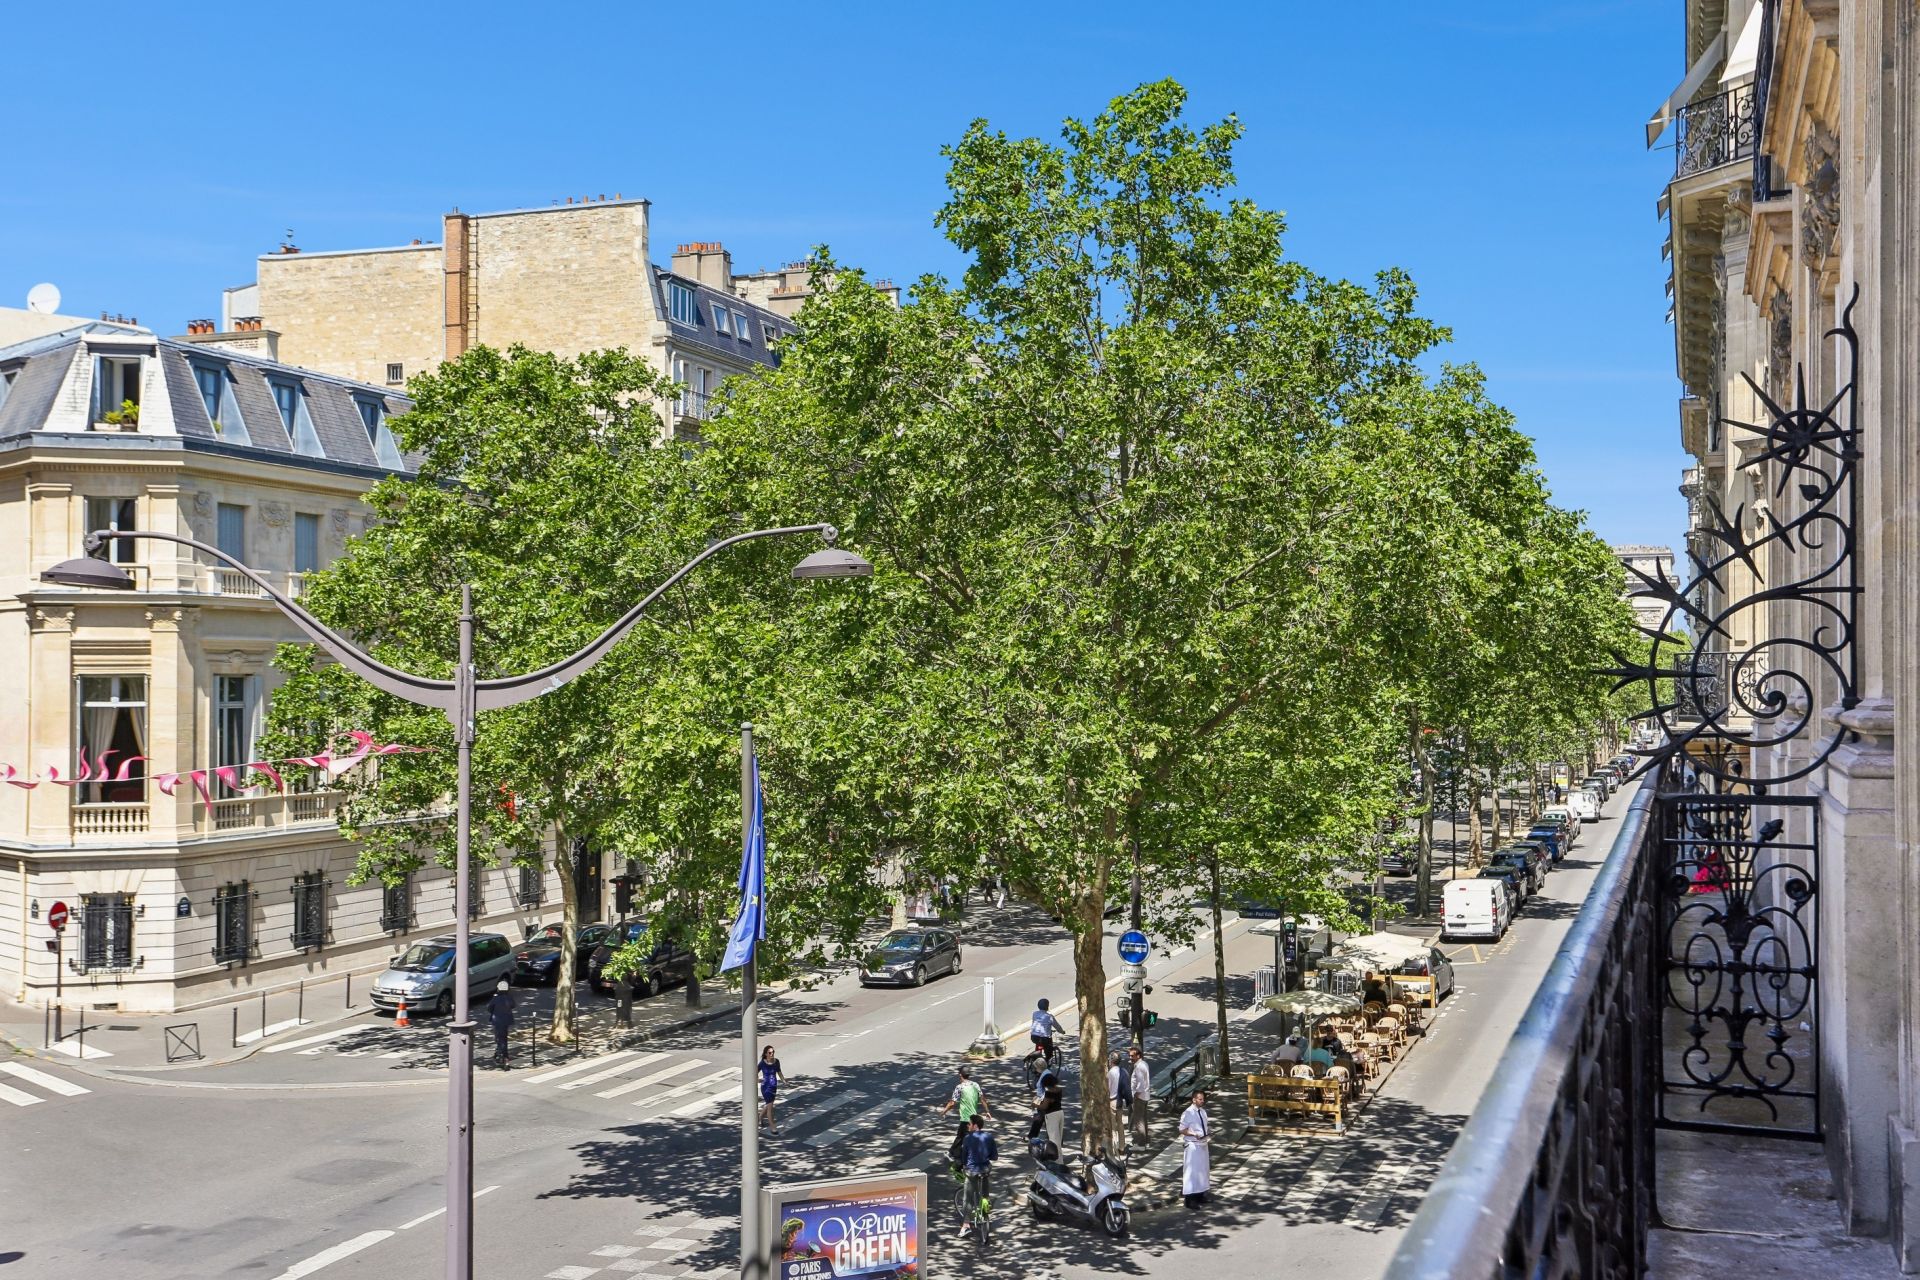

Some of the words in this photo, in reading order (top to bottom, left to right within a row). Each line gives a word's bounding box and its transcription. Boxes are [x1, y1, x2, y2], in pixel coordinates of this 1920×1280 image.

[877, 1213, 906, 1234] LOVE
[834, 1231, 907, 1272] GREEN
[800, 1260, 821, 1274] PARIS
